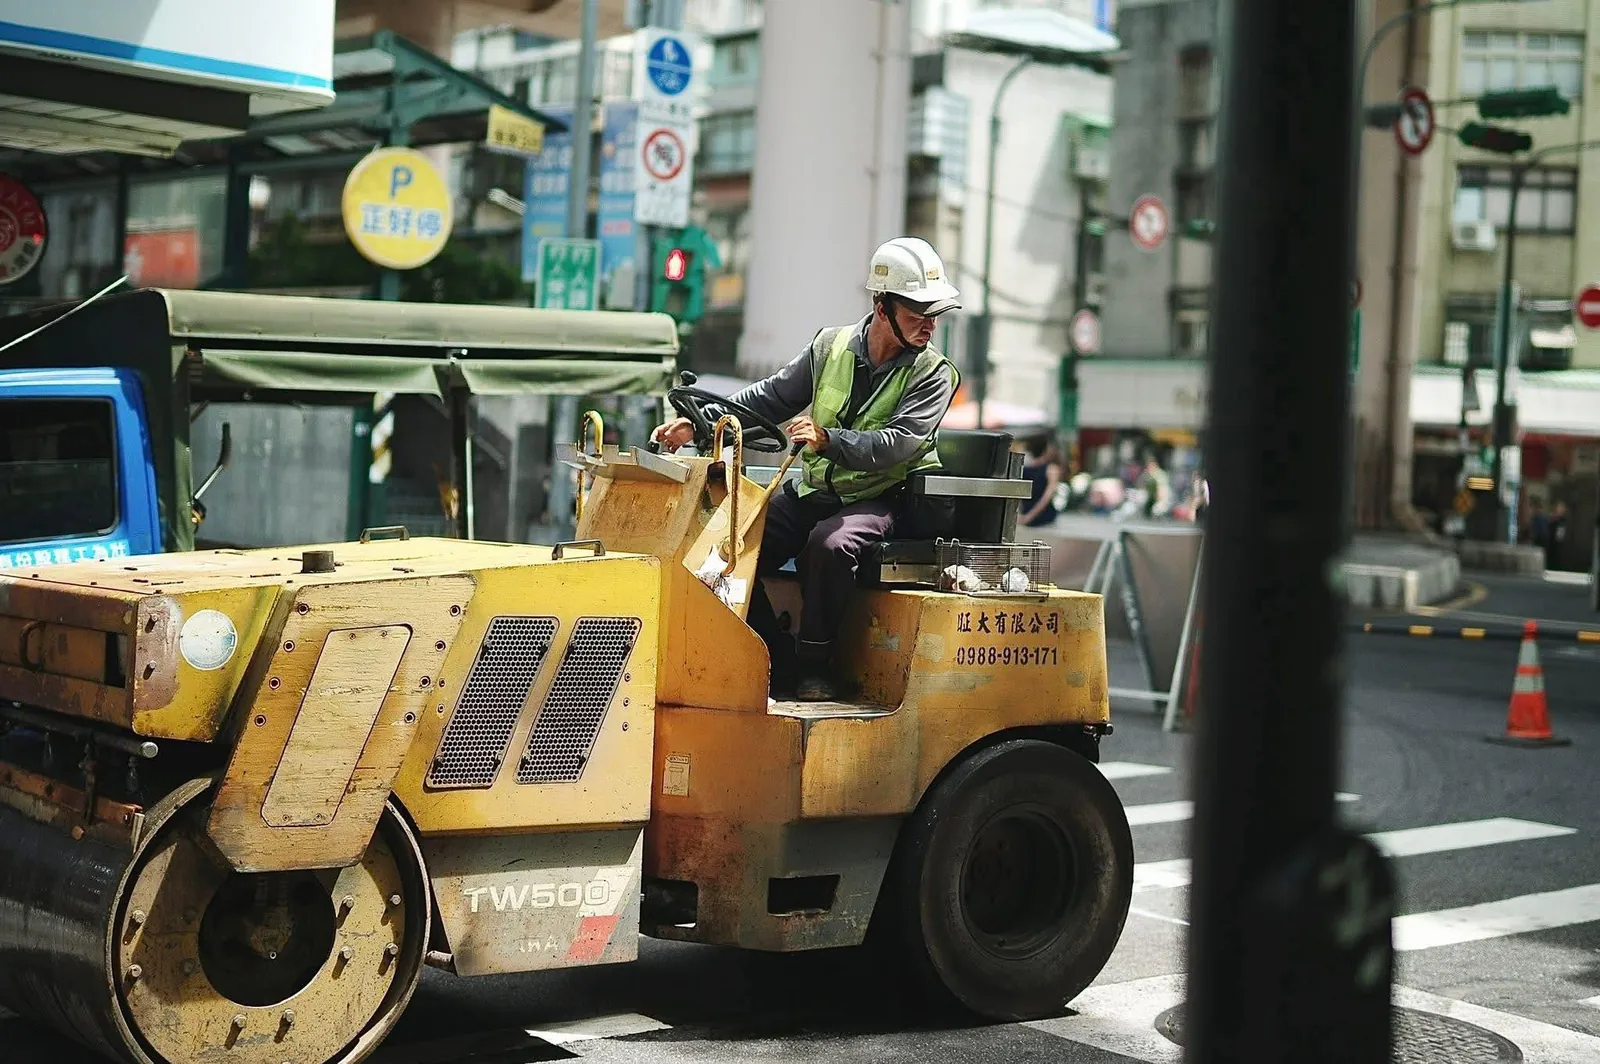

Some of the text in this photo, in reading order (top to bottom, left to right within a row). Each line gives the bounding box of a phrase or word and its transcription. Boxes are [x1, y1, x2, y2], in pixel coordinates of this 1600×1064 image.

[389, 164, 413, 198] P
[361, 203, 441, 238] 正好停
[956, 611, 1059, 635] 旺大有限公司
[956, 646, 1058, 666] 0988-913-171
[463, 879, 610, 913] TW500
